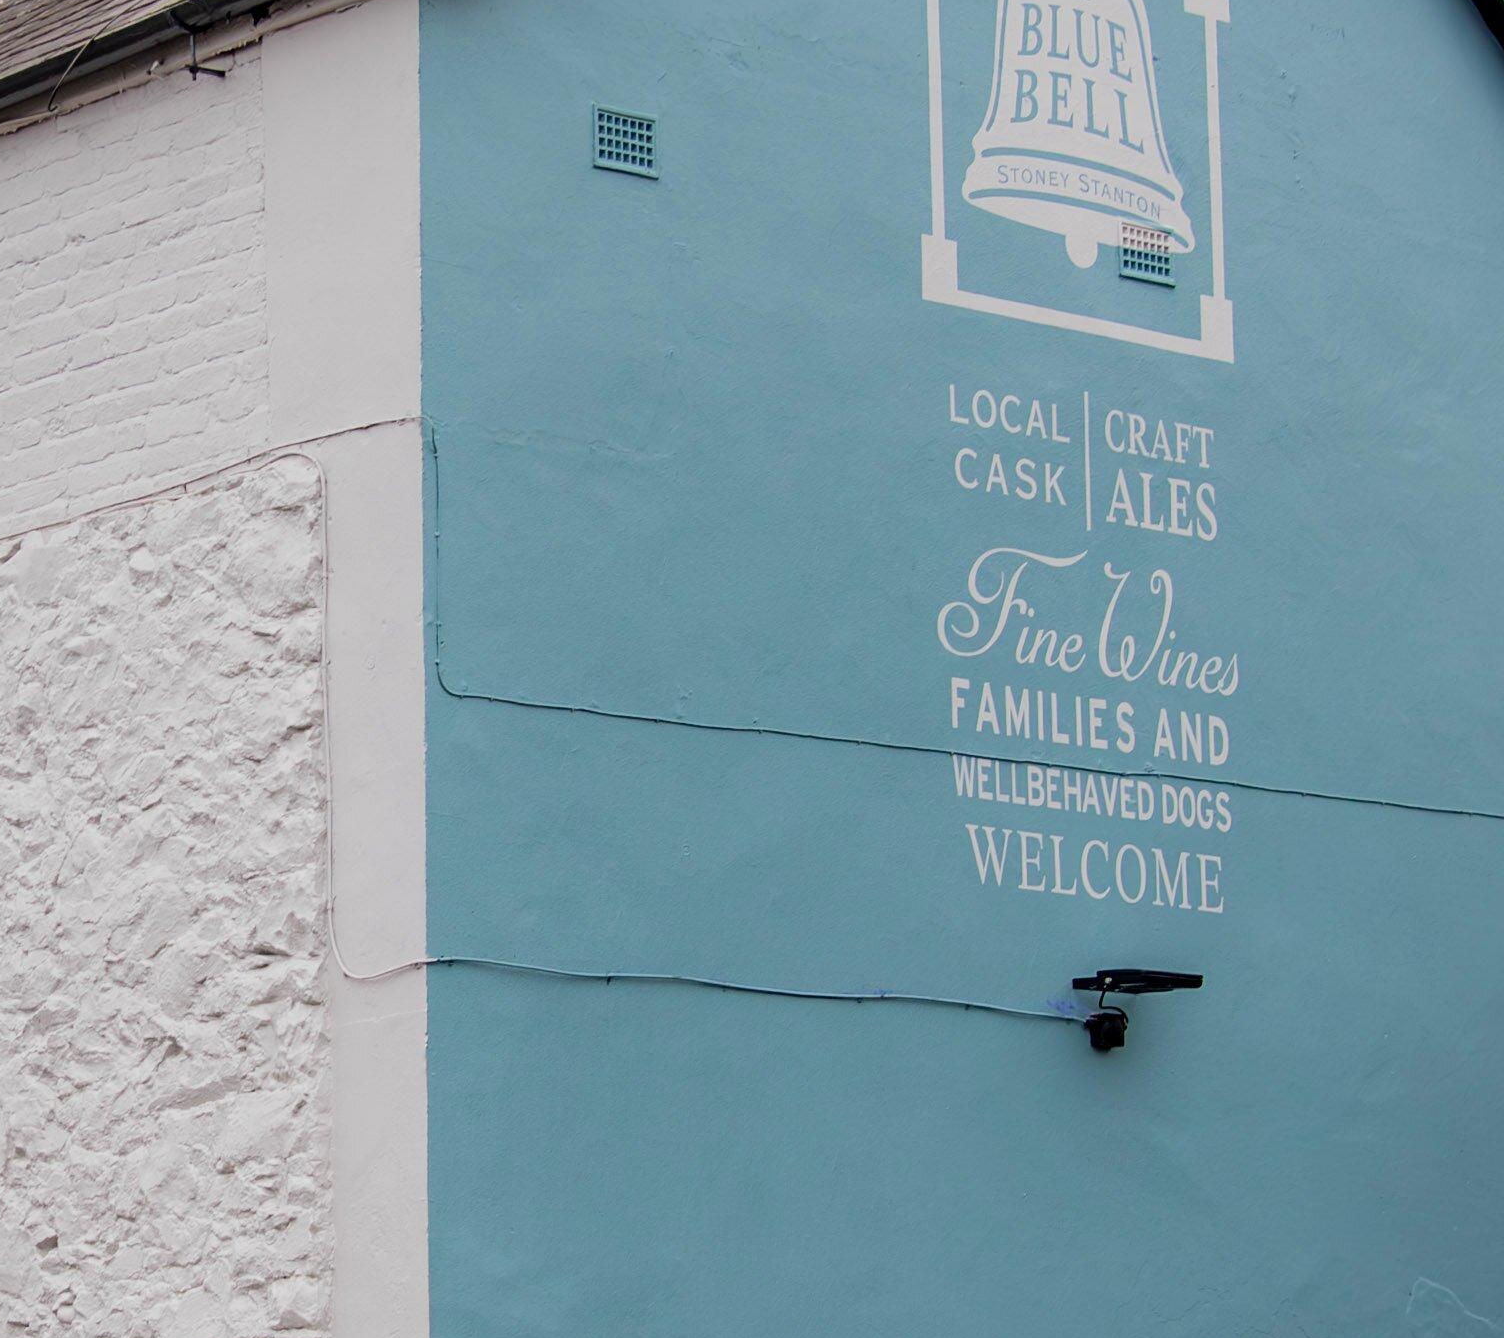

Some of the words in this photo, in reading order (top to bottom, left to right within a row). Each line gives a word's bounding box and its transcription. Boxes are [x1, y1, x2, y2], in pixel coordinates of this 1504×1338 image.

[1017, 2, 1133, 83] BLUE
[1010, 69, 1145, 155] BELL
[997, 164, 1070, 188] STONEY
[1078, 173, 1161, 219] STANTON
[949, 383, 1071, 444] LOCAL
[1104, 408, 1214, 469] CRAFT
[954, 447, 1067, 507] CASK
[1106, 467, 1219, 541] ALES
[937, 547, 1089, 673] Fine
[1097, 561, 1240, 697] Wines
[950, 676, 1137, 754] FAMILIES
[1153, 707, 1230, 766] AND
[951, 753, 1156, 822] WELLBEHAVED
[1161, 782, 1233, 833] DOGS
[965, 823, 1226, 914] WELCOME
